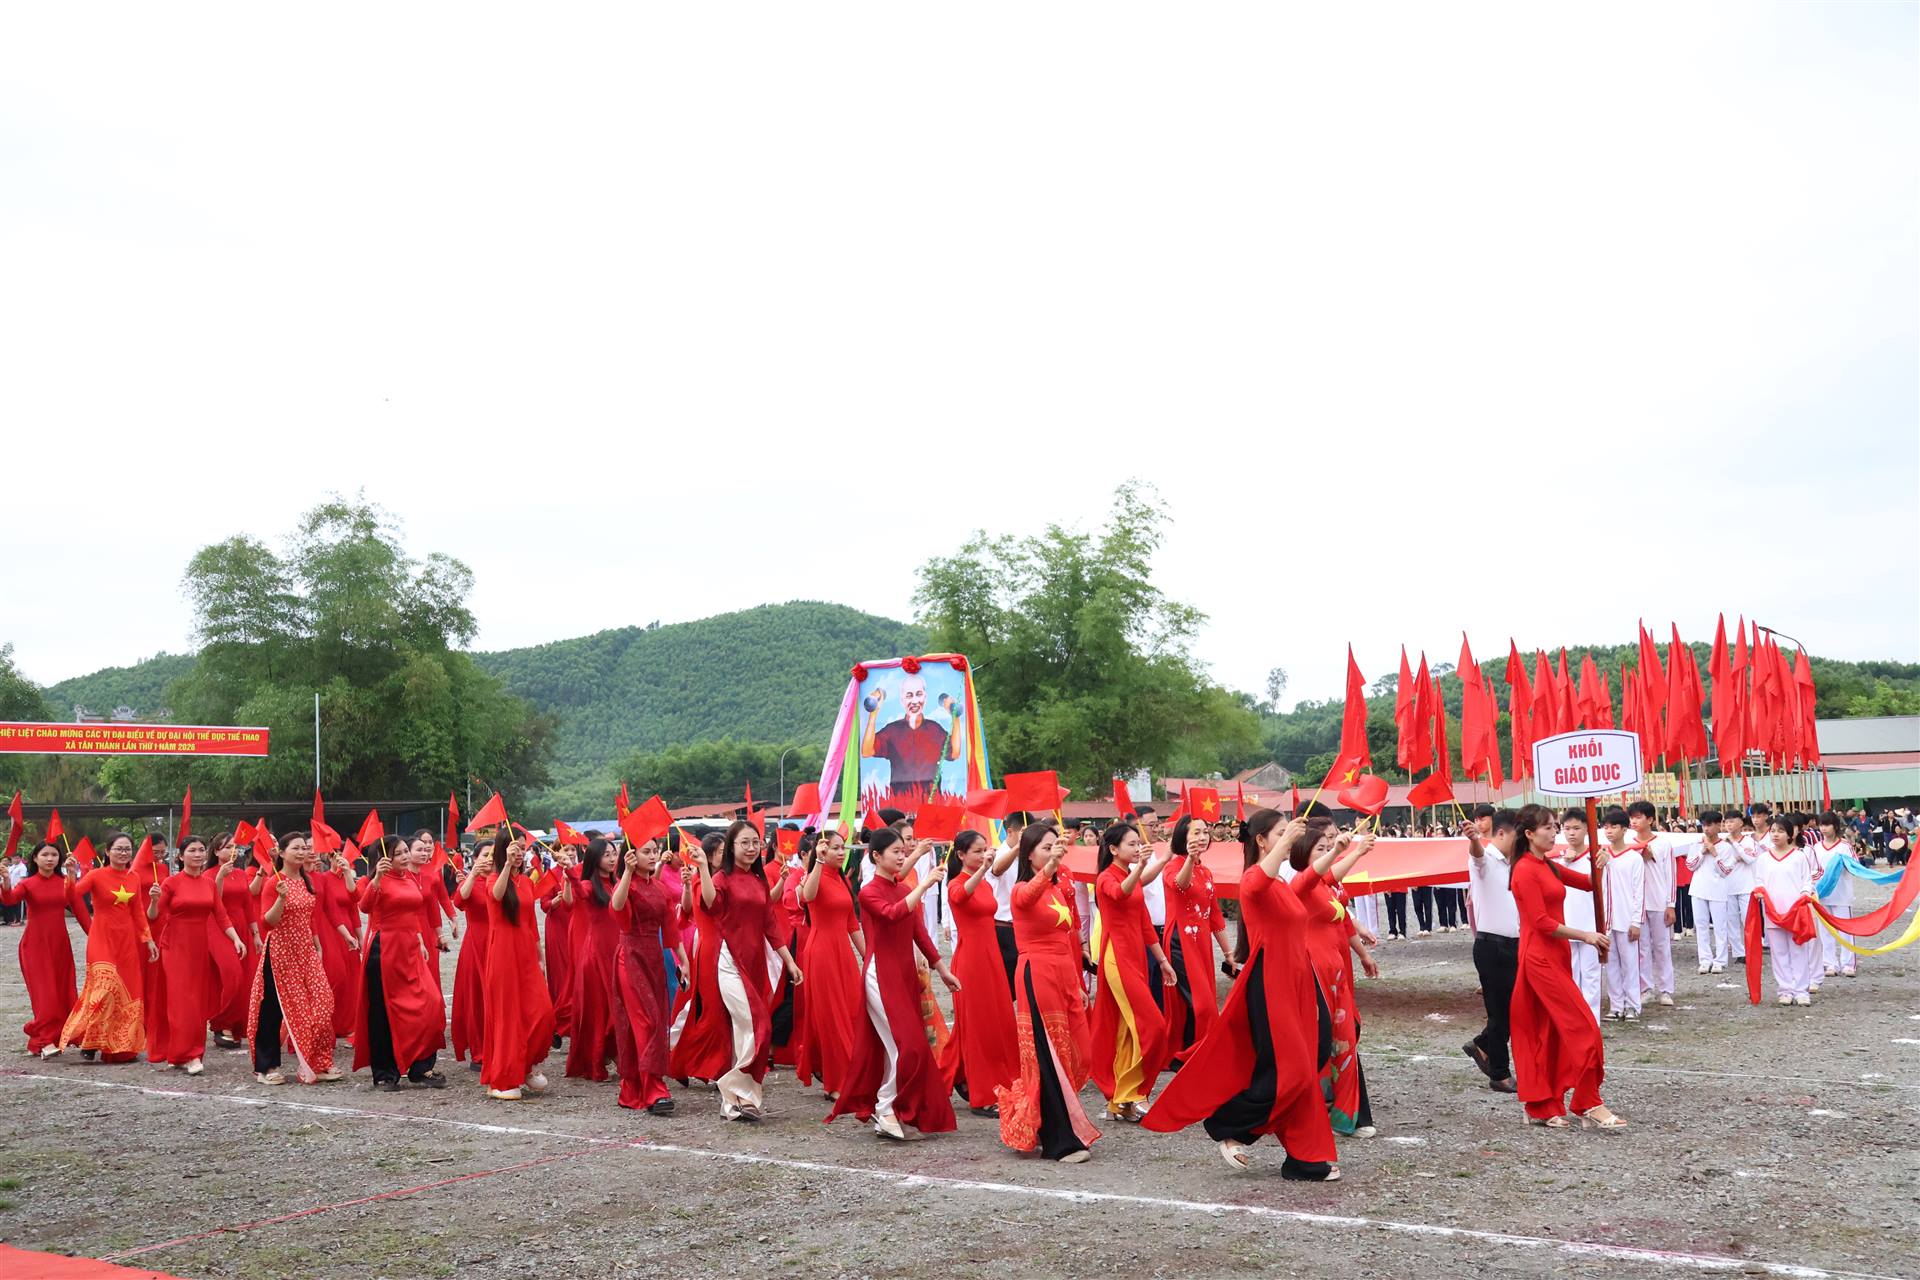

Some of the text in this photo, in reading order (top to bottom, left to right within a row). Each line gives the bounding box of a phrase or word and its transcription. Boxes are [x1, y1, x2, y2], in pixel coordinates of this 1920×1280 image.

[18, 728, 34, 738] LIỆT
[37, 728, 58, 737] CHÀO
[60, 728, 83, 738] MỪNG
[85, 729, 101, 738] CÁC
[103, 730, 110, 740] VỊ
[183, 731, 195, 741] HỘI
[78, 740, 94, 750] TÂN
[95, 740, 120, 750] THÀNH
[1569, 738, 1602, 759] KHỐI
[1555, 763, 1620, 785] GIÁO DỤC
